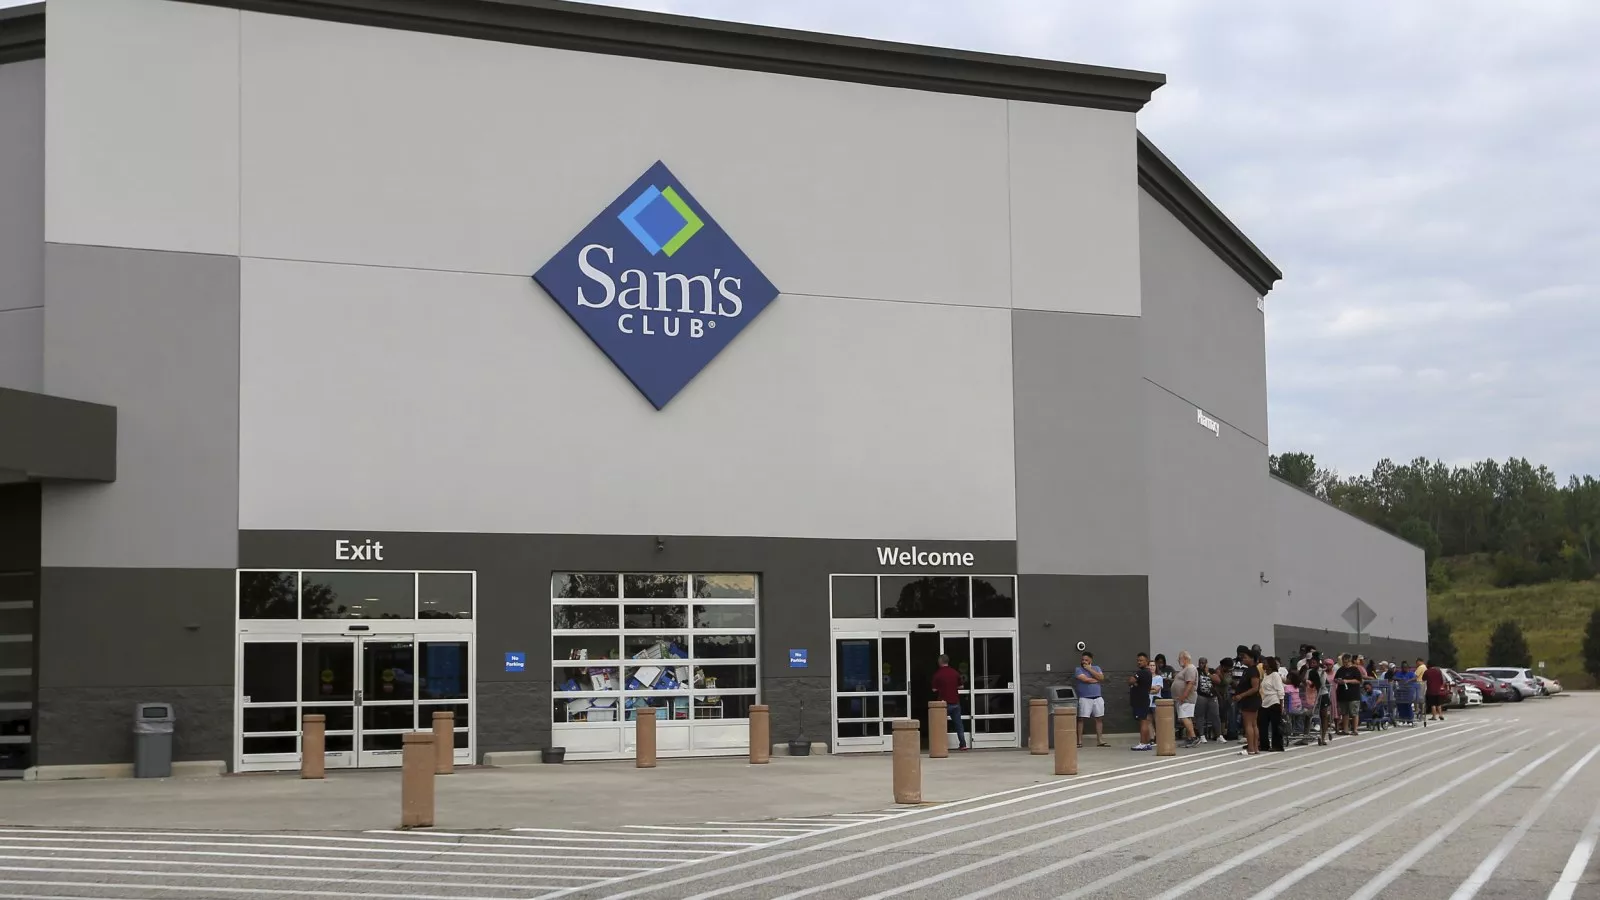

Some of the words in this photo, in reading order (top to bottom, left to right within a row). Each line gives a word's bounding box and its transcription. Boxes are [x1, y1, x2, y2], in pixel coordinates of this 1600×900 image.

[577, 244, 743, 318] Sam's
[335, 539, 384, 561] Exit
[876, 546, 975, 566] Welcome
